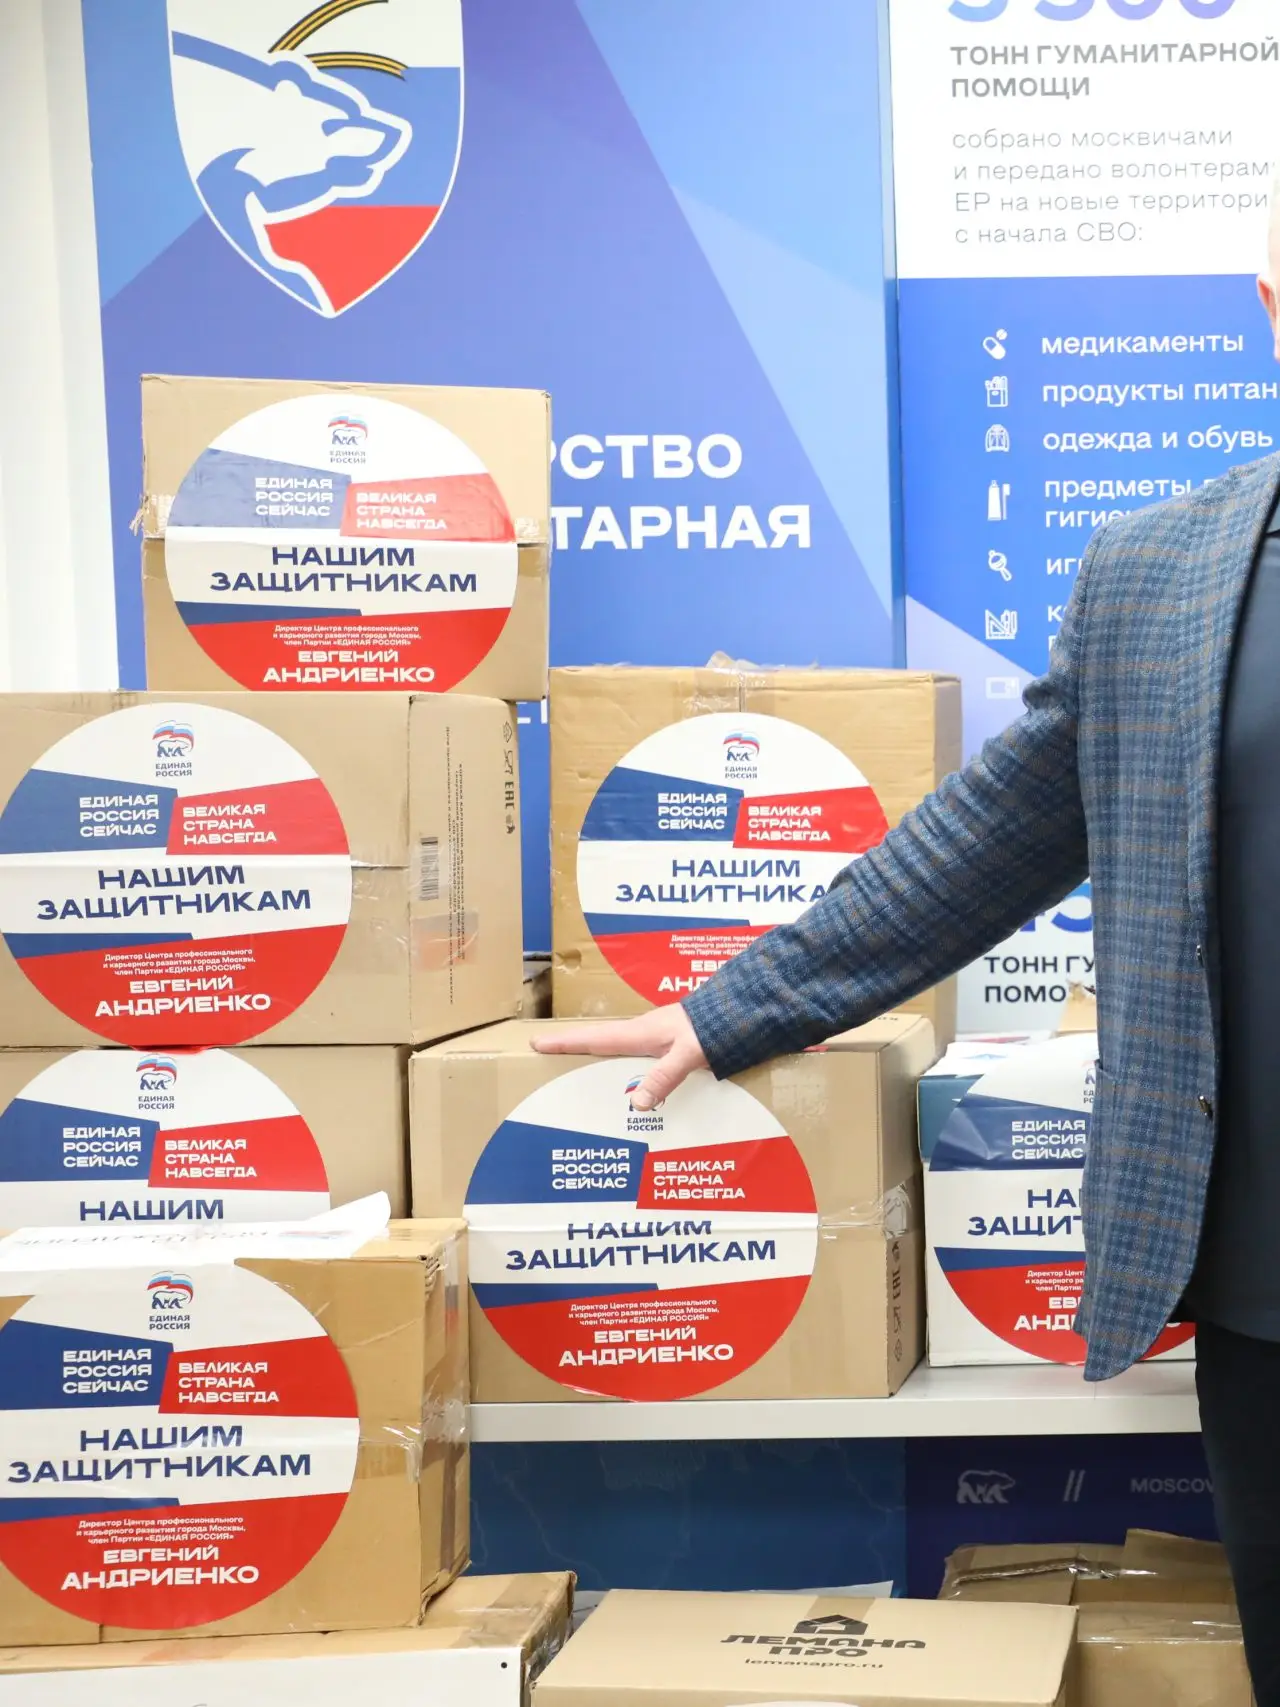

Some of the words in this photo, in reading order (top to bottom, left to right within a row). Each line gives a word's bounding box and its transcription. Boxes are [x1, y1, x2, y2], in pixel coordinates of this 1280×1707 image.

[950, 45, 1028, 65] ТОНН
[1037, 36, 1279, 64] ГУМАНИТАРНОЙ
[952, 77, 1089, 100] ПОМОЩИ
[952, 128, 1061, 153] собрано
[1072, 130, 1232, 147] москвичами
[954, 166, 966, 180] и
[978, 164, 1101, 184] передано
[956, 192, 990, 212] ЕР
[1001, 196, 1028, 211] на
[1039, 195, 1119, 211] новые
[1129, 194, 1268, 213] территори
[955, 229, 968, 243] с
[979, 228, 1066, 243] начала
[1077, 221, 1142, 242] СВО:
[1042, 335, 1243, 356] медикаменты
[1043, 384, 1184, 407] продукты
[1043, 432, 1152, 452] одежда
[1162, 432, 1178, 448] и
[1187, 425, 1273, 453] обувь
[550, 433, 742, 480] СТВО
[255, 477, 332, 489] ЕДИНАЯ
[255, 491, 333, 503] РОССИЯ
[357, 492, 436, 503] ВЕЛИКАЯ
[1045, 479, 1191, 502] предметы
[256, 503, 330, 516] СЕЙЧАС
[357, 505, 425, 516] СТРАНА
[357, 518, 447, 529] НАВСЕГДА
[272, 547, 414, 566] НАШИМ
[210, 572, 476, 592] ЗАЩИТНИКАМ
[298, 649, 398, 662] ЕВГЕНИЙ
[263, 667, 435, 683] АНДРИЕНКО
[155, 762, 192, 770] ЕДИНАЯ
[79, 794, 158, 808] ЕДИНАЯ
[658, 793, 727, 804] ЕДИНАЯ
[80, 809, 159, 822] РОССИЯ
[183, 804, 265, 817] ВЕЛИКАЯ
[658, 806, 727, 816] РОССИЯ
[748, 806, 821, 816] ВЕЛИКАЯ
[80, 823, 156, 837] СЕЙЧАС
[183, 818, 254, 831] СТРАНА
[658, 817, 725, 830] СЕЙЧАС
[748, 818, 811, 828] СТРАНА
[184, 831, 277, 845] НАВСЕГДА
[748, 830, 830, 841] НАВСЕГДА
[672, 860, 800, 877] НАШИМ
[98, 865, 245, 890] НАШИМ
[615, 884, 829, 903] ЗАЩИТНИКА
[37, 889, 311, 920] ЗАЩИТНИКАМ
[984, 956, 1058, 974] ТОНН
[130, 975, 233, 994] ЕВГЕНИЙ
[985, 985, 1066, 1003] ПОМО
[95, 994, 271, 1017] АНДРИЕНКО
[63, 1127, 140, 1139] ЕДИНАЯ
[1012, 1120, 1085, 1132] ЕДИНАЯ
[63, 1141, 141, 1153] РОССИЯ
[165, 1139, 246, 1151] ВЕЛИКАЯ
[1012, 1134, 1086, 1146] РОССИЯ
[63, 1154, 138, 1167] СЕЙЧАС
[165, 1153, 235, 1164] СТРАНА
[552, 1148, 629, 1161] ЕДИНАЯ
[1012, 1147, 1084, 1160] СЕЙЧАС
[165, 1166, 257, 1178] НАВСЕГДА
[552, 1163, 630, 1175] РОССИЯ
[654, 1160, 735, 1172] ВЕЛИКАЯ
[552, 1176, 627, 1189] СЕЙЧАС
[654, 1175, 723, 1186] СТРАНА
[654, 1188, 745, 1200] НАВСЕГДА
[80, 1199, 223, 1221] НАШИМ
[567, 1221, 712, 1240] НАШИМ
[506, 1240, 776, 1270] ЗАЩИТНИКАМ
[149, 1315, 190, 1323] ЕДИНАЯ
[594, 1325, 696, 1343] ЕВГЕНИЙ
[63, 1348, 151, 1363] ЕДИНАЯ
[559, 1344, 734, 1366] АНДРИЕНКО
[63, 1364, 152, 1378] РОССИЯ
[179, 1362, 268, 1373] ВЕЛИКАЯ
[63, 1379, 148, 1394] СЕЙЧАС
[179, 1377, 255, 1388] СТРАНА
[179, 1391, 279, 1403] НАВСЕГДА
[80, 1425, 242, 1452] НАШИМ
[8, 1454, 310, 1483] ЗАЩИТНИКАМ
[103, 1544, 219, 1564] ЕВГЕНИЙ
[61, 1566, 259, 1590] АНДРИЕНКО
[720, 1635, 926, 1649] ЛЕМАНА
[769, 1646, 868, 1657] ПРО
